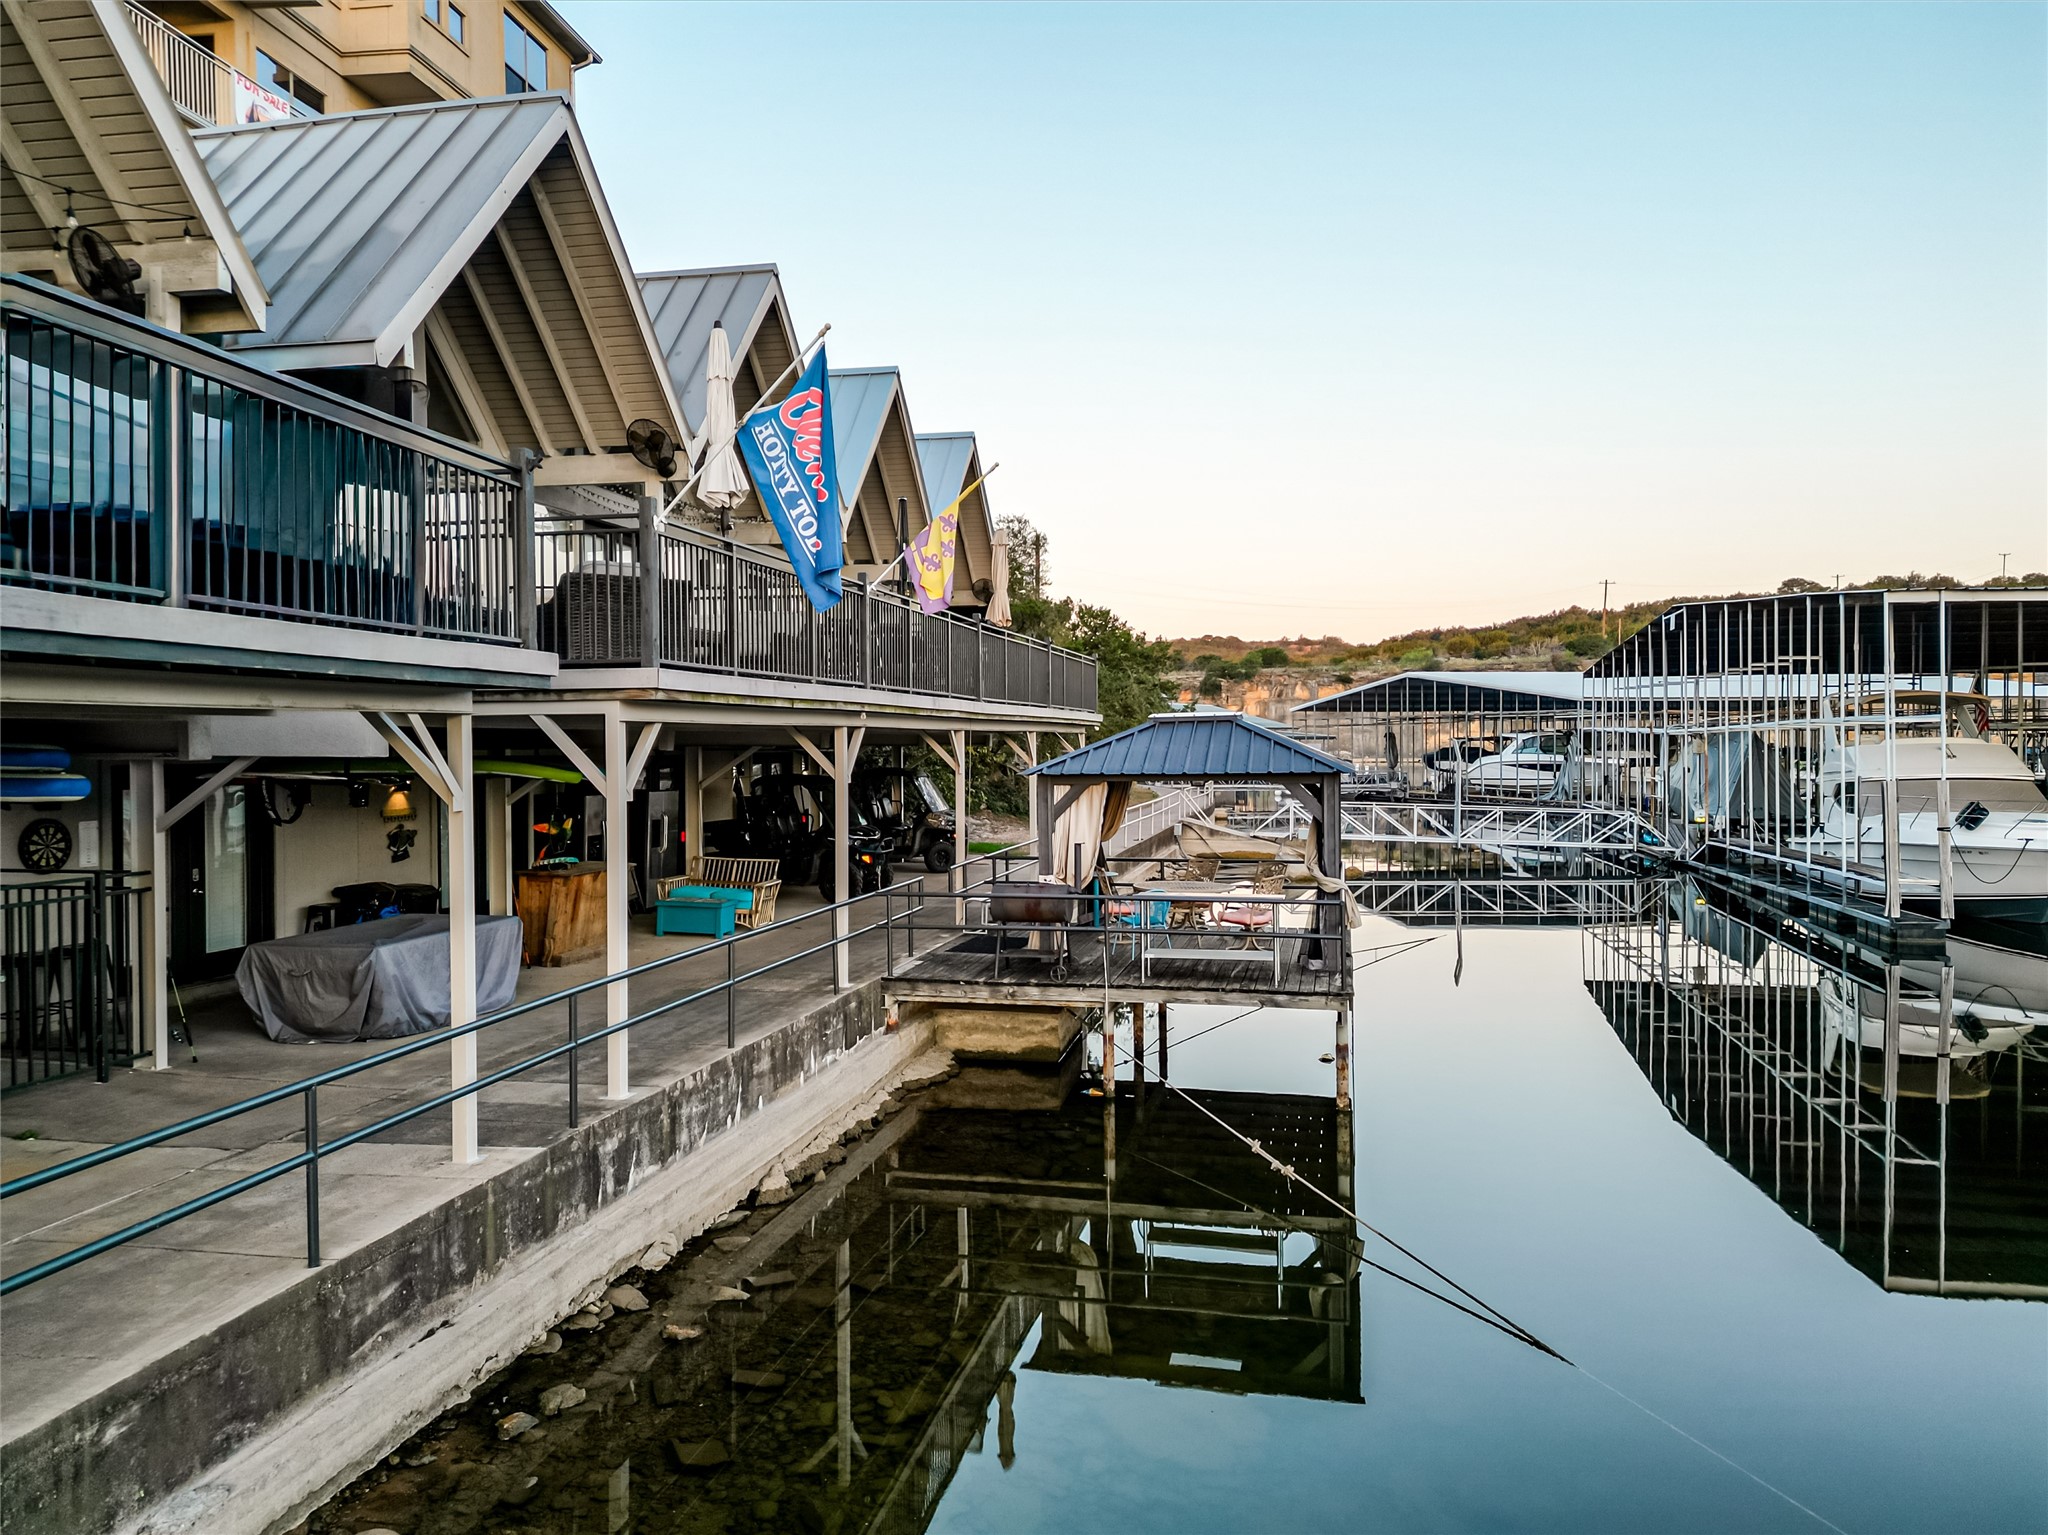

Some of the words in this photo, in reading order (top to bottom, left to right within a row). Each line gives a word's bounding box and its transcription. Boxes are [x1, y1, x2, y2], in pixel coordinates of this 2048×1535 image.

[236, 72, 260, 97] FOR
[262, 91, 289, 115] SALE
[755, 419, 800, 498] HOTTY
[790, 498, 822, 558] TOD
